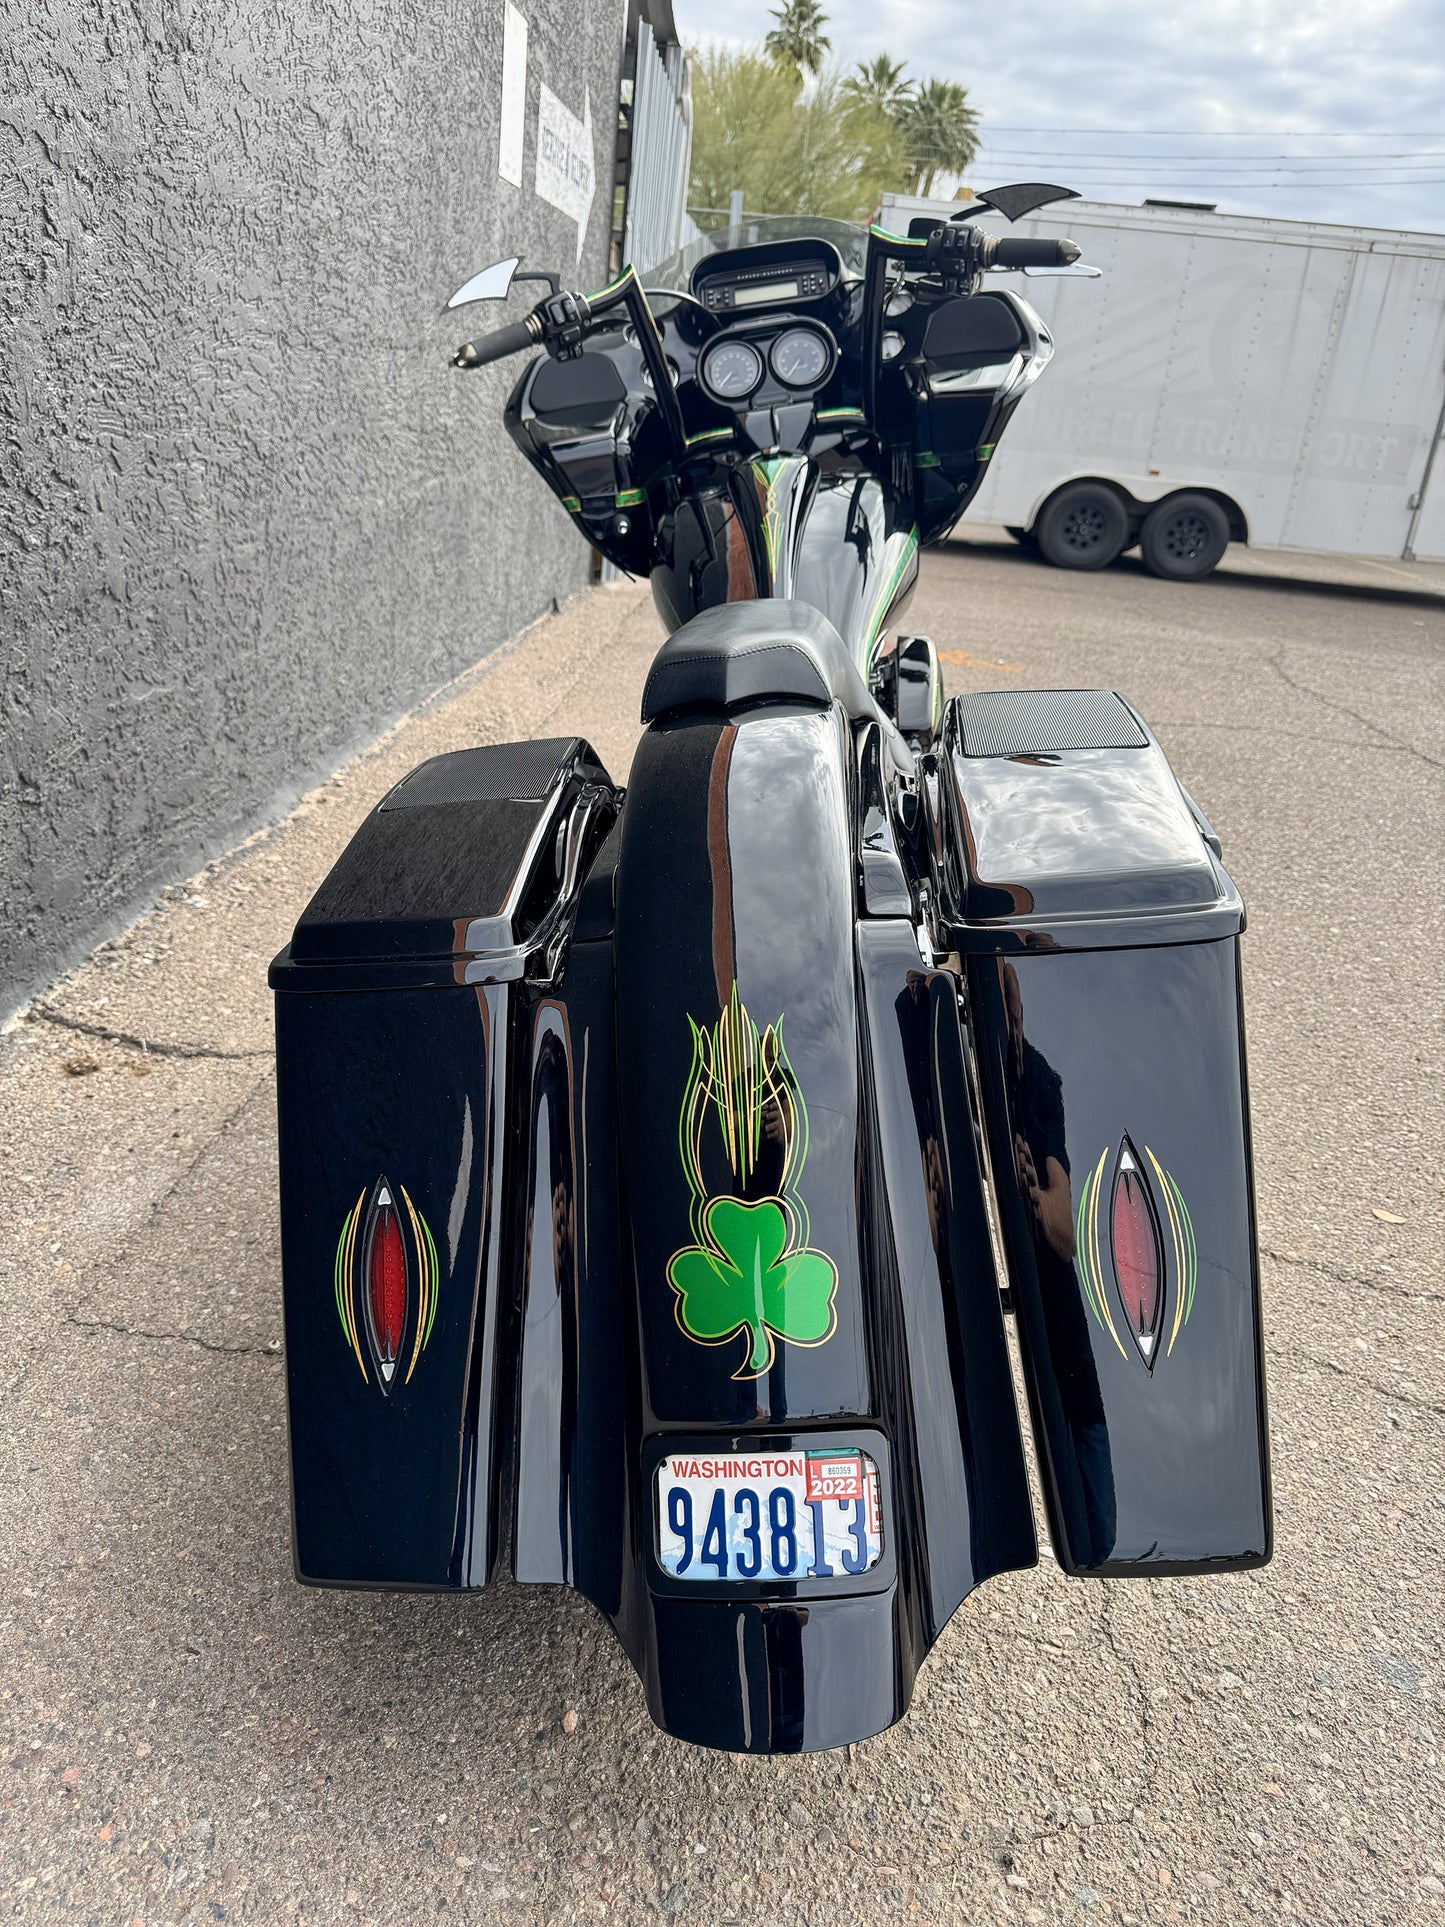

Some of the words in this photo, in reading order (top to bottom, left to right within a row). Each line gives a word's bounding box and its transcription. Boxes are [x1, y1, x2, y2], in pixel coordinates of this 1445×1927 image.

[672, 1459, 803, 1479] WASHINGTON
[810, 1465, 818, 1478] L
[811, 1478, 858, 1497] 2022
[667, 1486, 868, 1578] 943813
